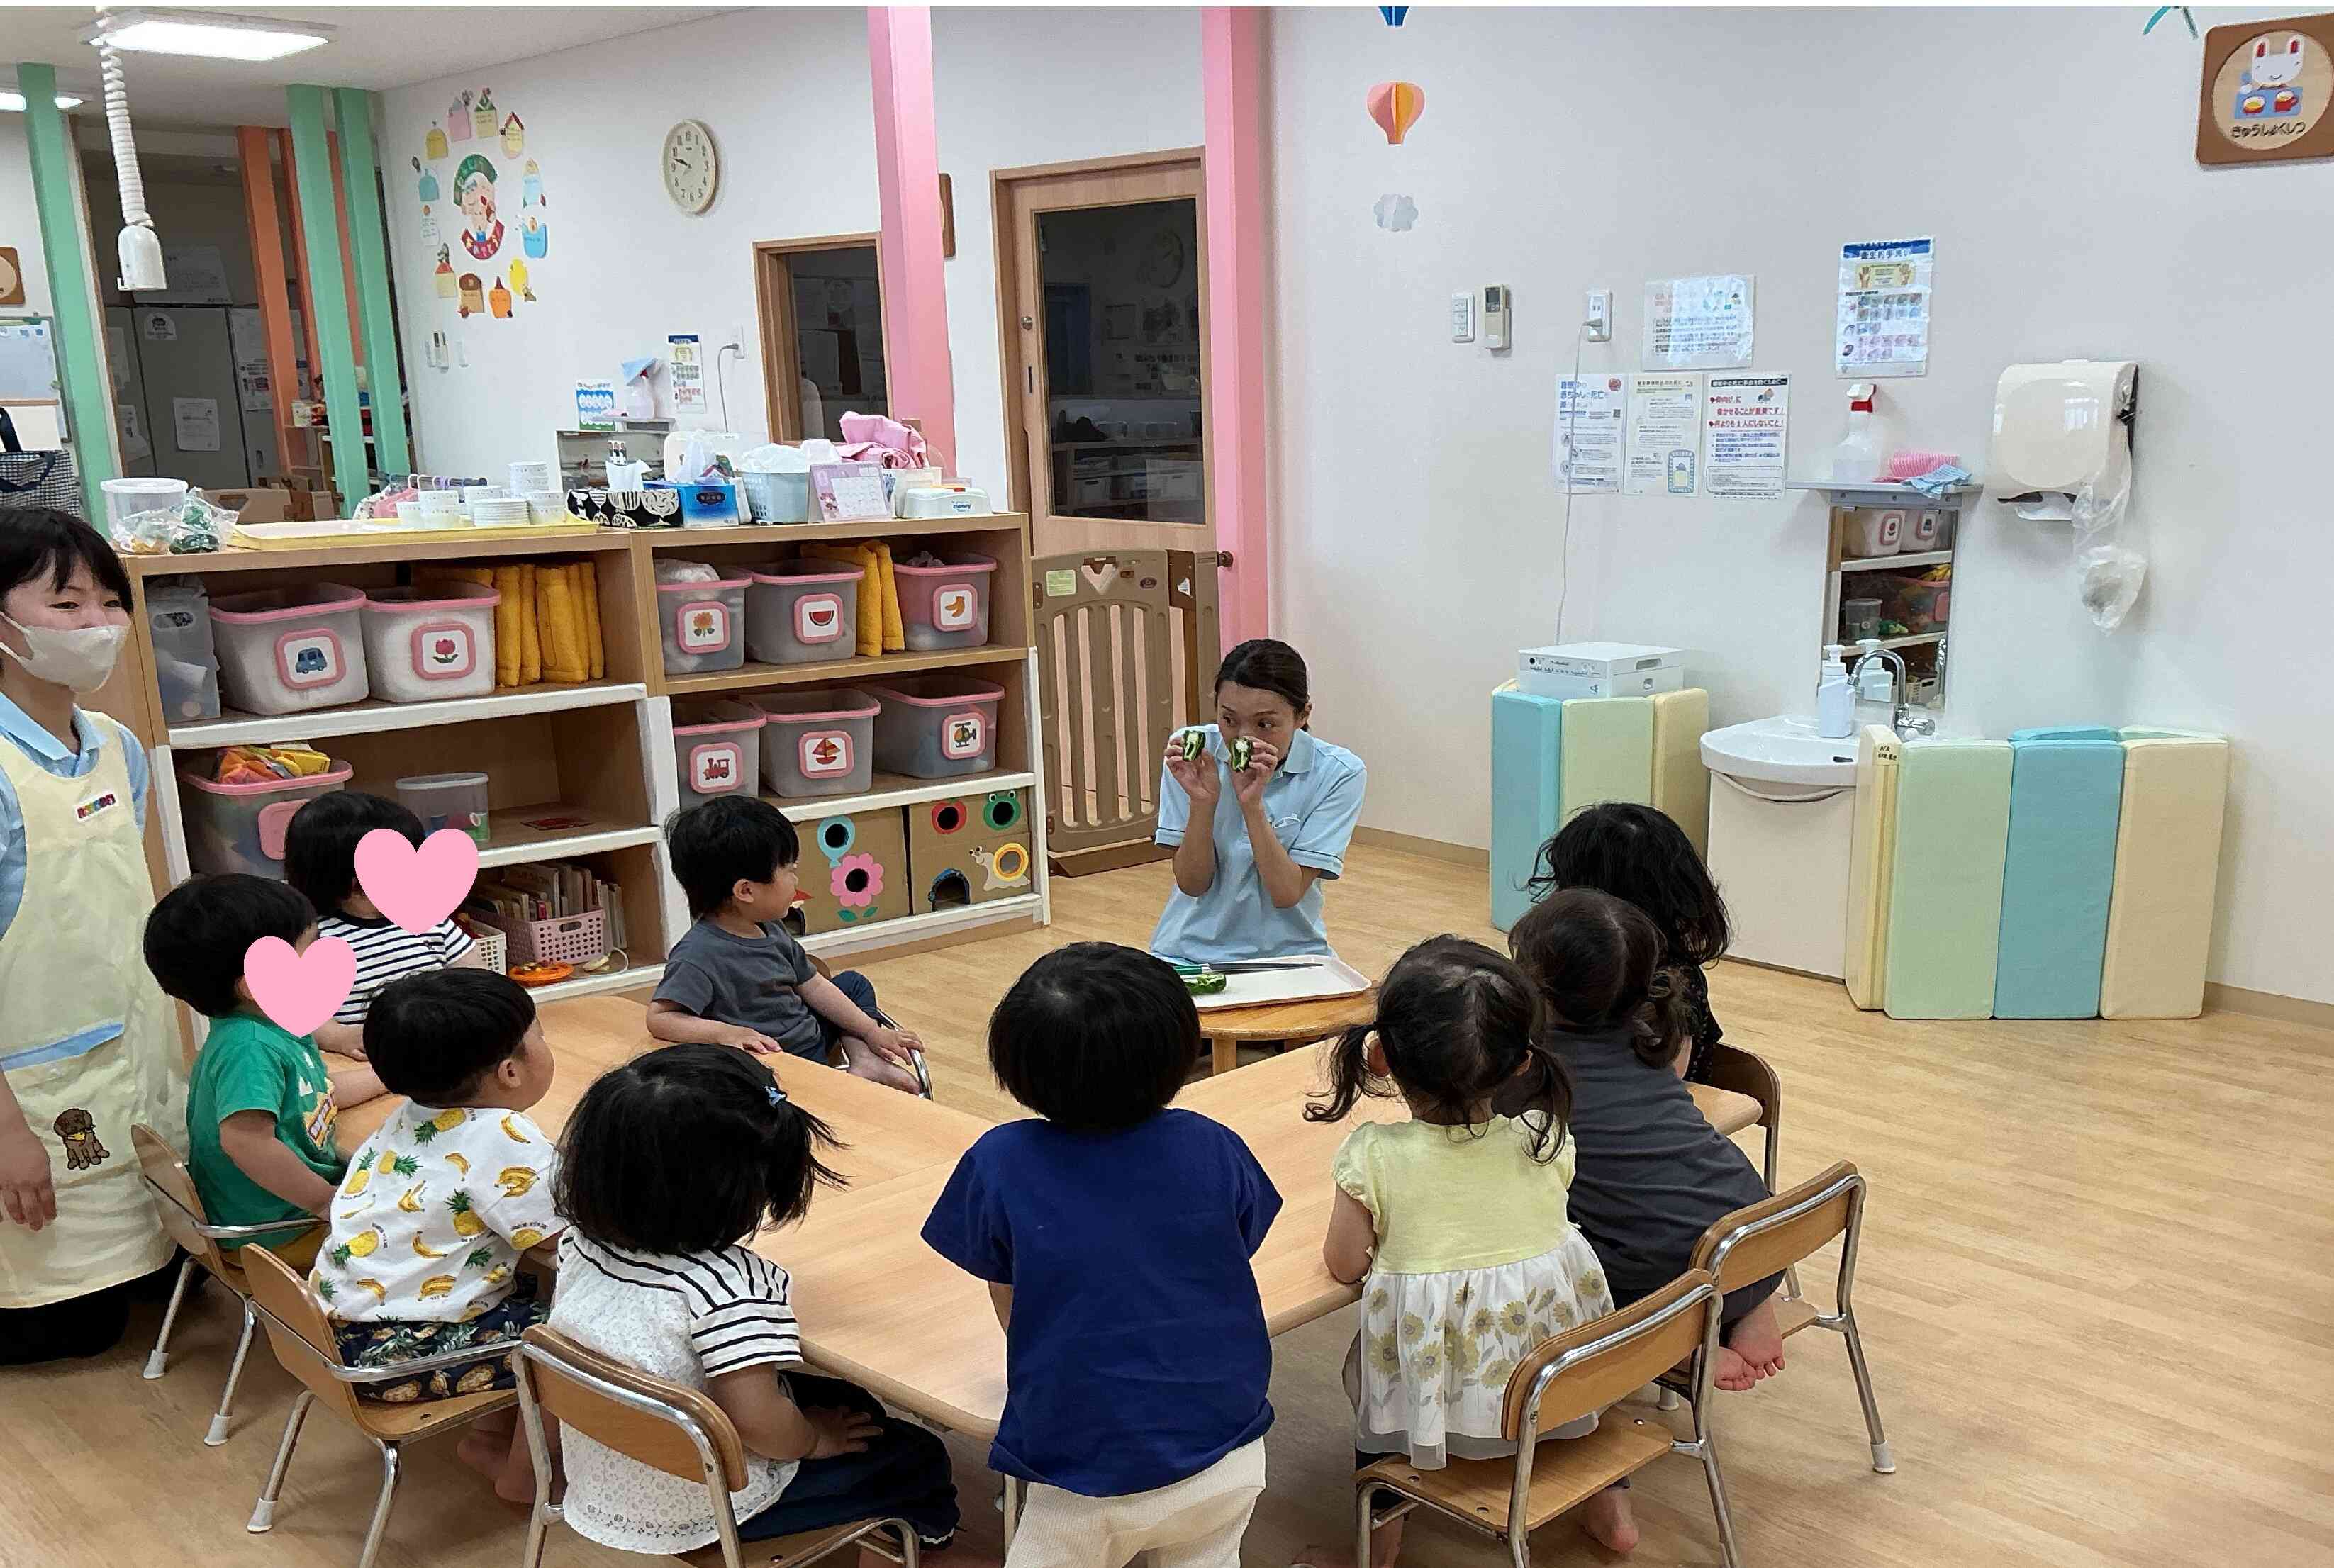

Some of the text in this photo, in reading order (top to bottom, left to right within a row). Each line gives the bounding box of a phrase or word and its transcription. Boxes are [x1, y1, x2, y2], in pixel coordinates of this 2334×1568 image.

[2231, 121, 2306, 138] きゅうしょくしつ
